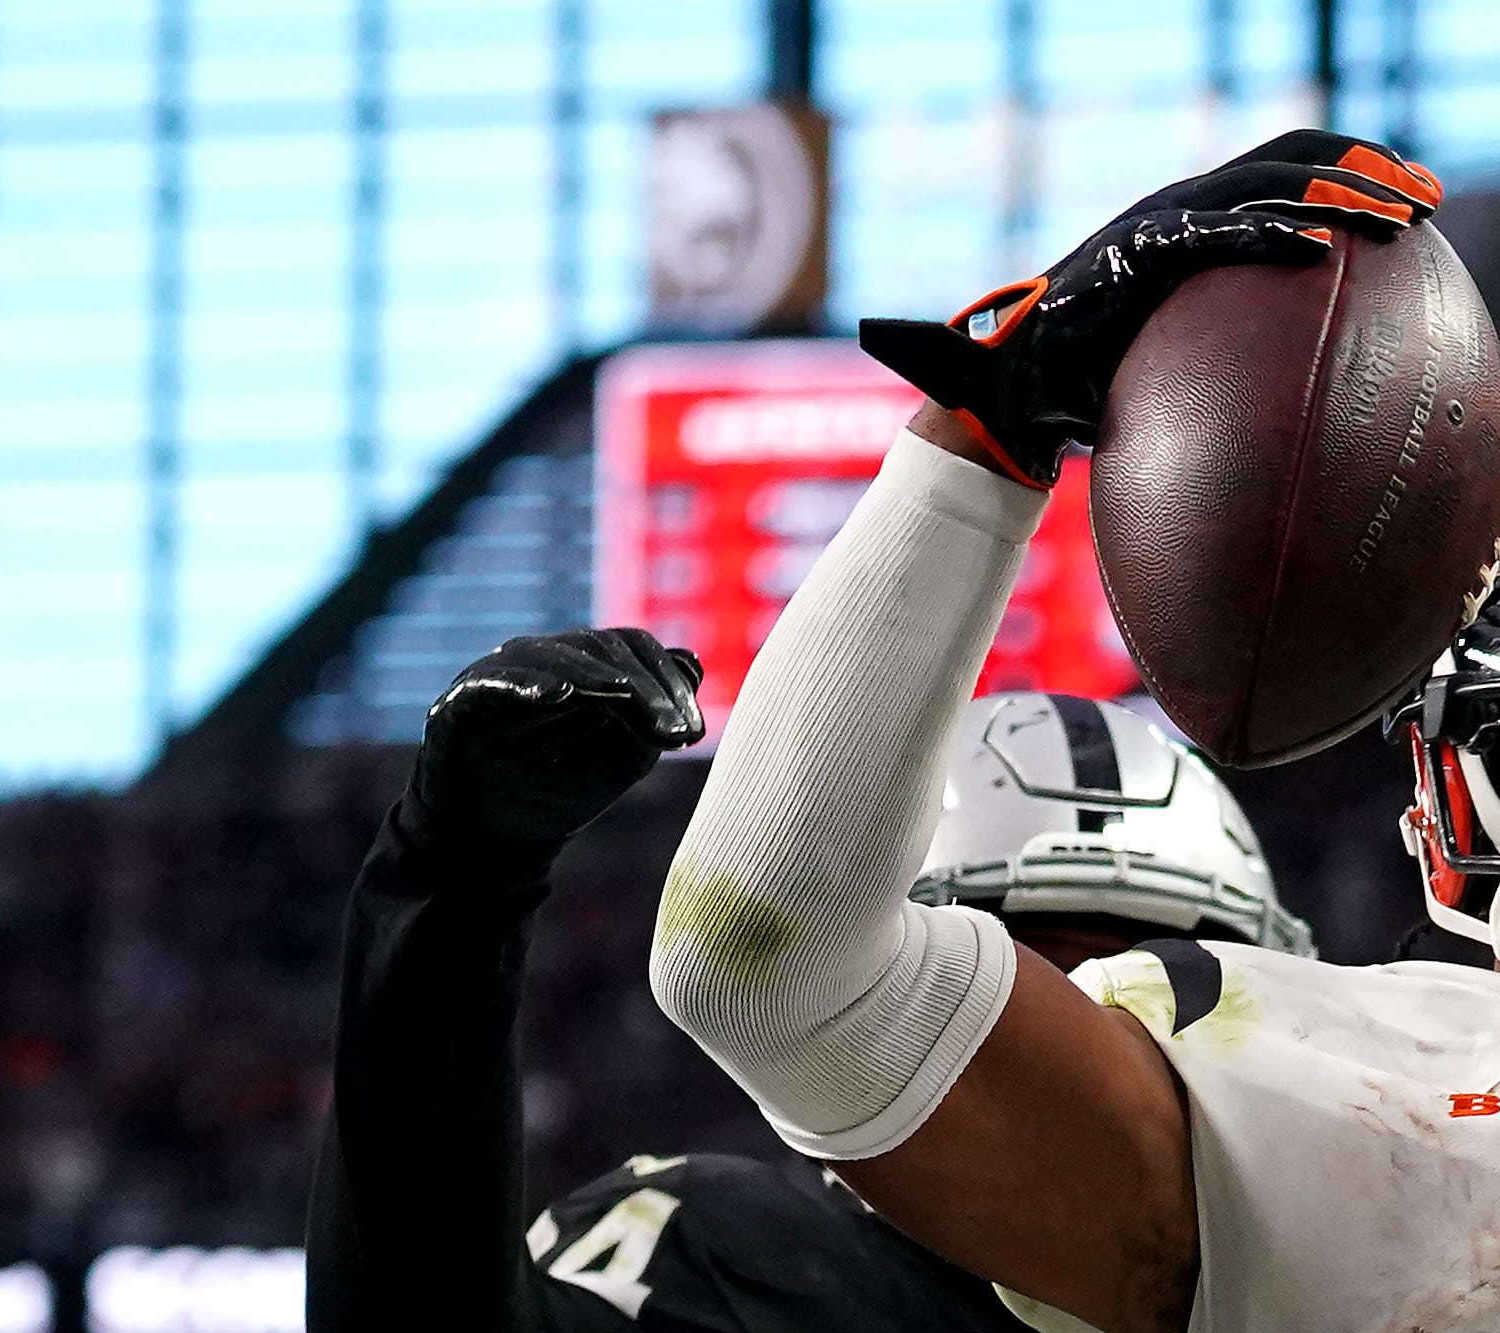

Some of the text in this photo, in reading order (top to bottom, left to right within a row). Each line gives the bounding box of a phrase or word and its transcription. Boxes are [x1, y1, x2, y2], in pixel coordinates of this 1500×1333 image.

[1402, 339, 1444, 470] FOOTBALL
[1350, 473, 1407, 574] LEAGUE
[525, 1187, 684, 1321] 4
